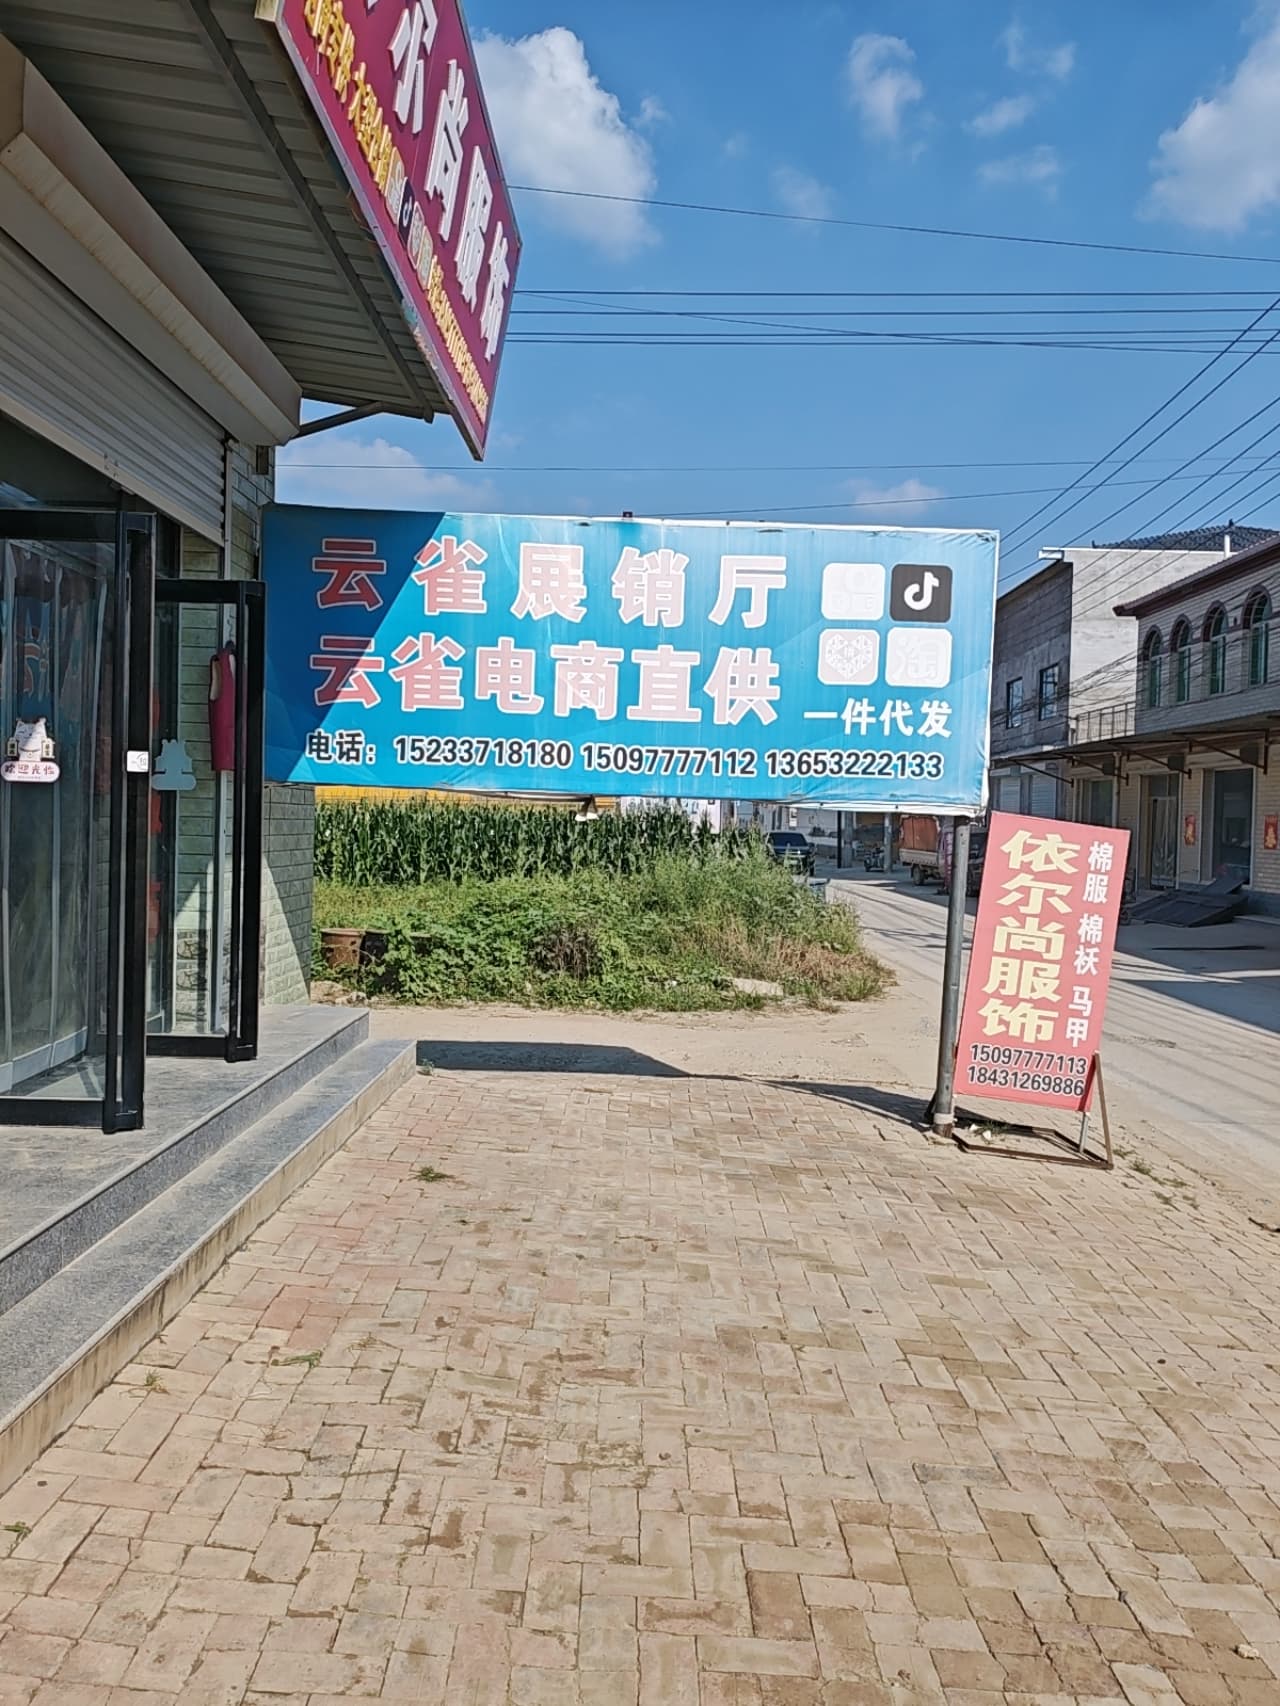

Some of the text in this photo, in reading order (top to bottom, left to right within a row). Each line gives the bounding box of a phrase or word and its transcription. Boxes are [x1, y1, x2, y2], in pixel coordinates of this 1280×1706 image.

[367, 0, 510, 363] 尔尚服饰
[312, 535, 788, 630] 云雀展销厅
[309, 632, 781, 726] 云雀电商直供
[803, 696, 953, 739] 一件代发
[394, 736, 573, 768] 15233718180
[580, 744, 757, 777] 15097777112
[765, 750, 944, 780] 13653222133
[977, 829, 1082, 1044] 依尔尚服饰
[1064, 840, 1115, 1048] 棉服 棉袄 马甲
[967, 1065, 1085, 1097] 18431269886
[970, 1043, 1088, 1076] 15097777113
